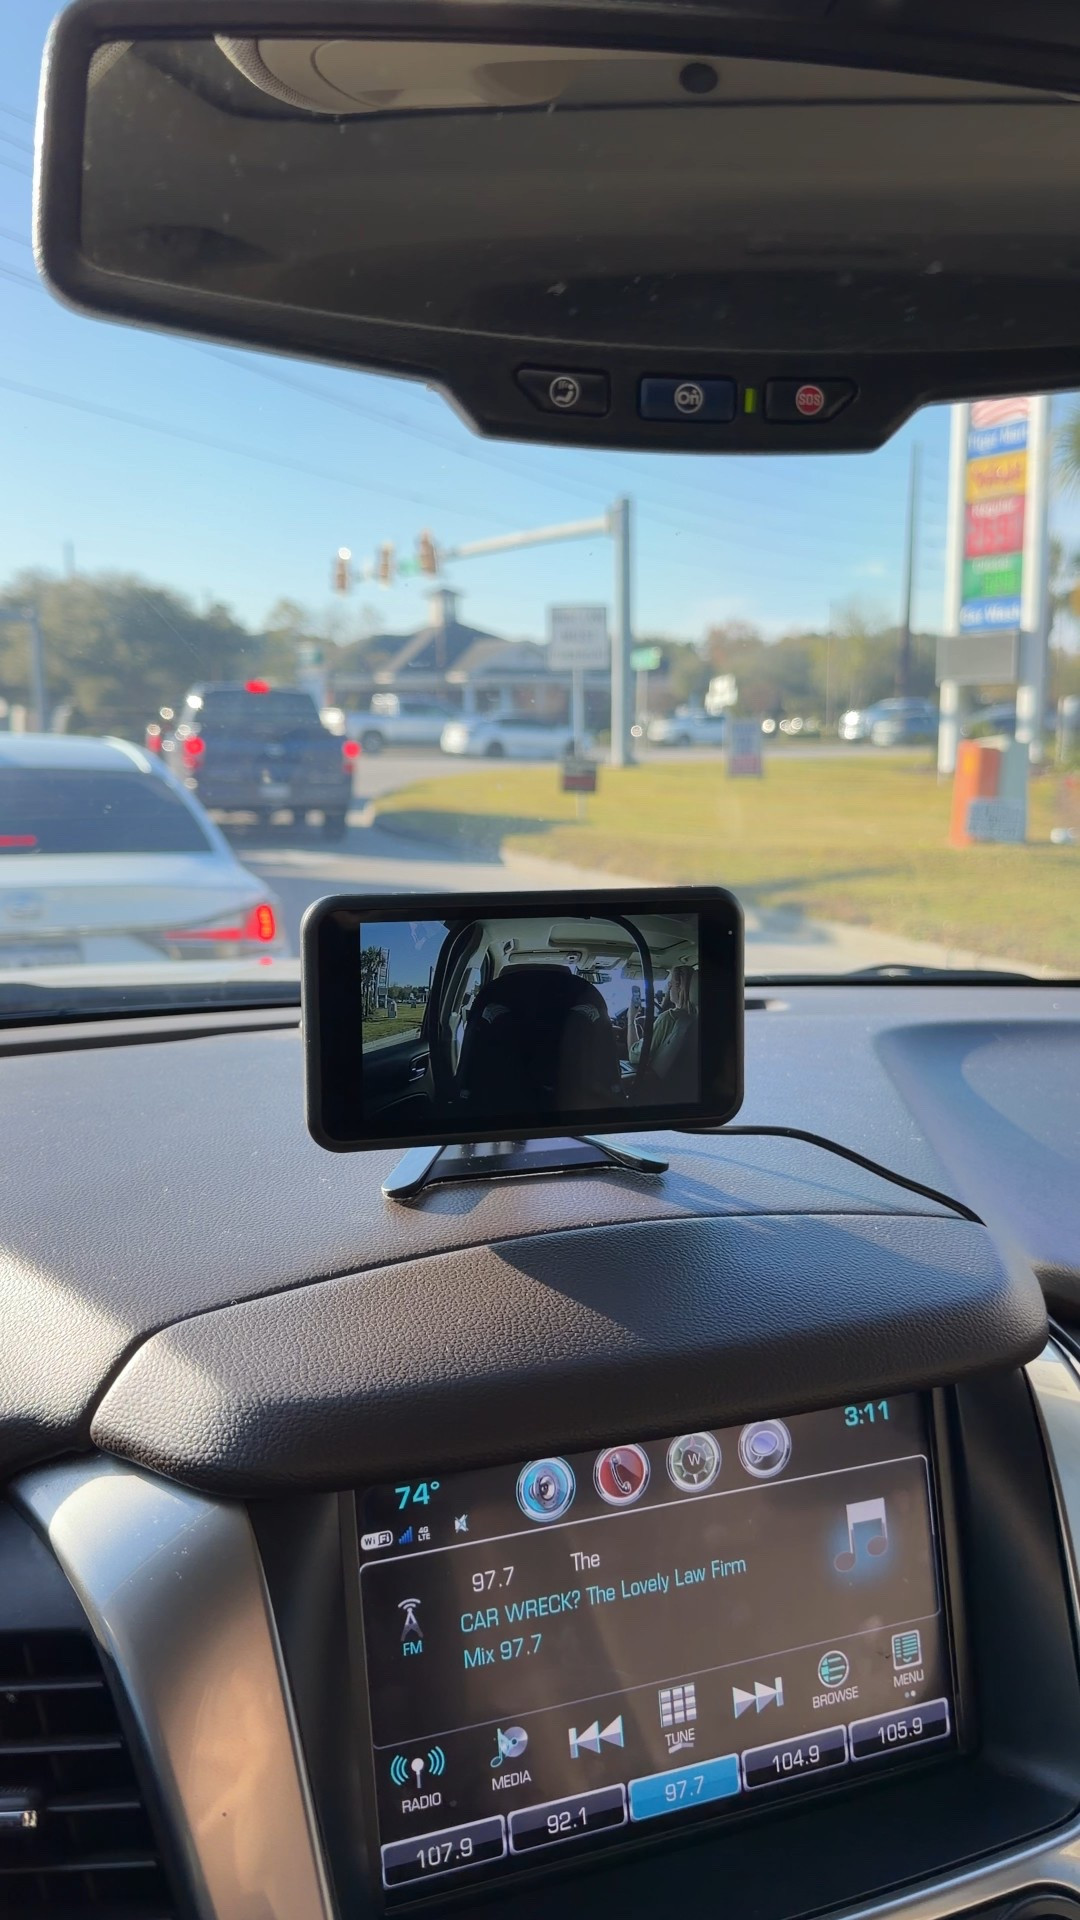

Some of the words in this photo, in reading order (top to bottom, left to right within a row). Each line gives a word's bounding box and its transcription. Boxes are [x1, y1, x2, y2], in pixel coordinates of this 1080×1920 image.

[799, 393, 821, 406] SOS
[844, 1400, 890, 1427] 3:11
[394, 1481, 440, 1510] 74°
[418, 1533, 431, 1541] LTE
[570, 1552, 601, 1571] The
[472, 1566, 514, 1593] 97.7
[461, 1607, 499, 1633] CAR
[504, 1590, 581, 1623] WRECK?
[585, 1585, 616, 1605] The
[621, 1572, 669, 1599] Lovely
[674, 1567, 706, 1587] Law
[711, 1559, 747, 1579] Firm
[402, 1640, 424, 1656] FM
[463, 1647, 496, 1669] Mix
[499, 1633, 543, 1660] 97.7
[893, 1669, 925, 1688] MENU
[812, 1685, 860, 1709] BROWSE
[665, 1727, 696, 1747] TUNE
[877, 1717, 924, 1745] 105.9
[772, 1745, 821, 1774] 104.9
[491, 1769, 532, 1791] MEDIA
[664, 1776, 705, 1802] 97.7
[401, 1792, 442, 1814] RADIO
[546, 1806, 588, 1834] 92.1
[416, 1837, 473, 1869] 107.9
